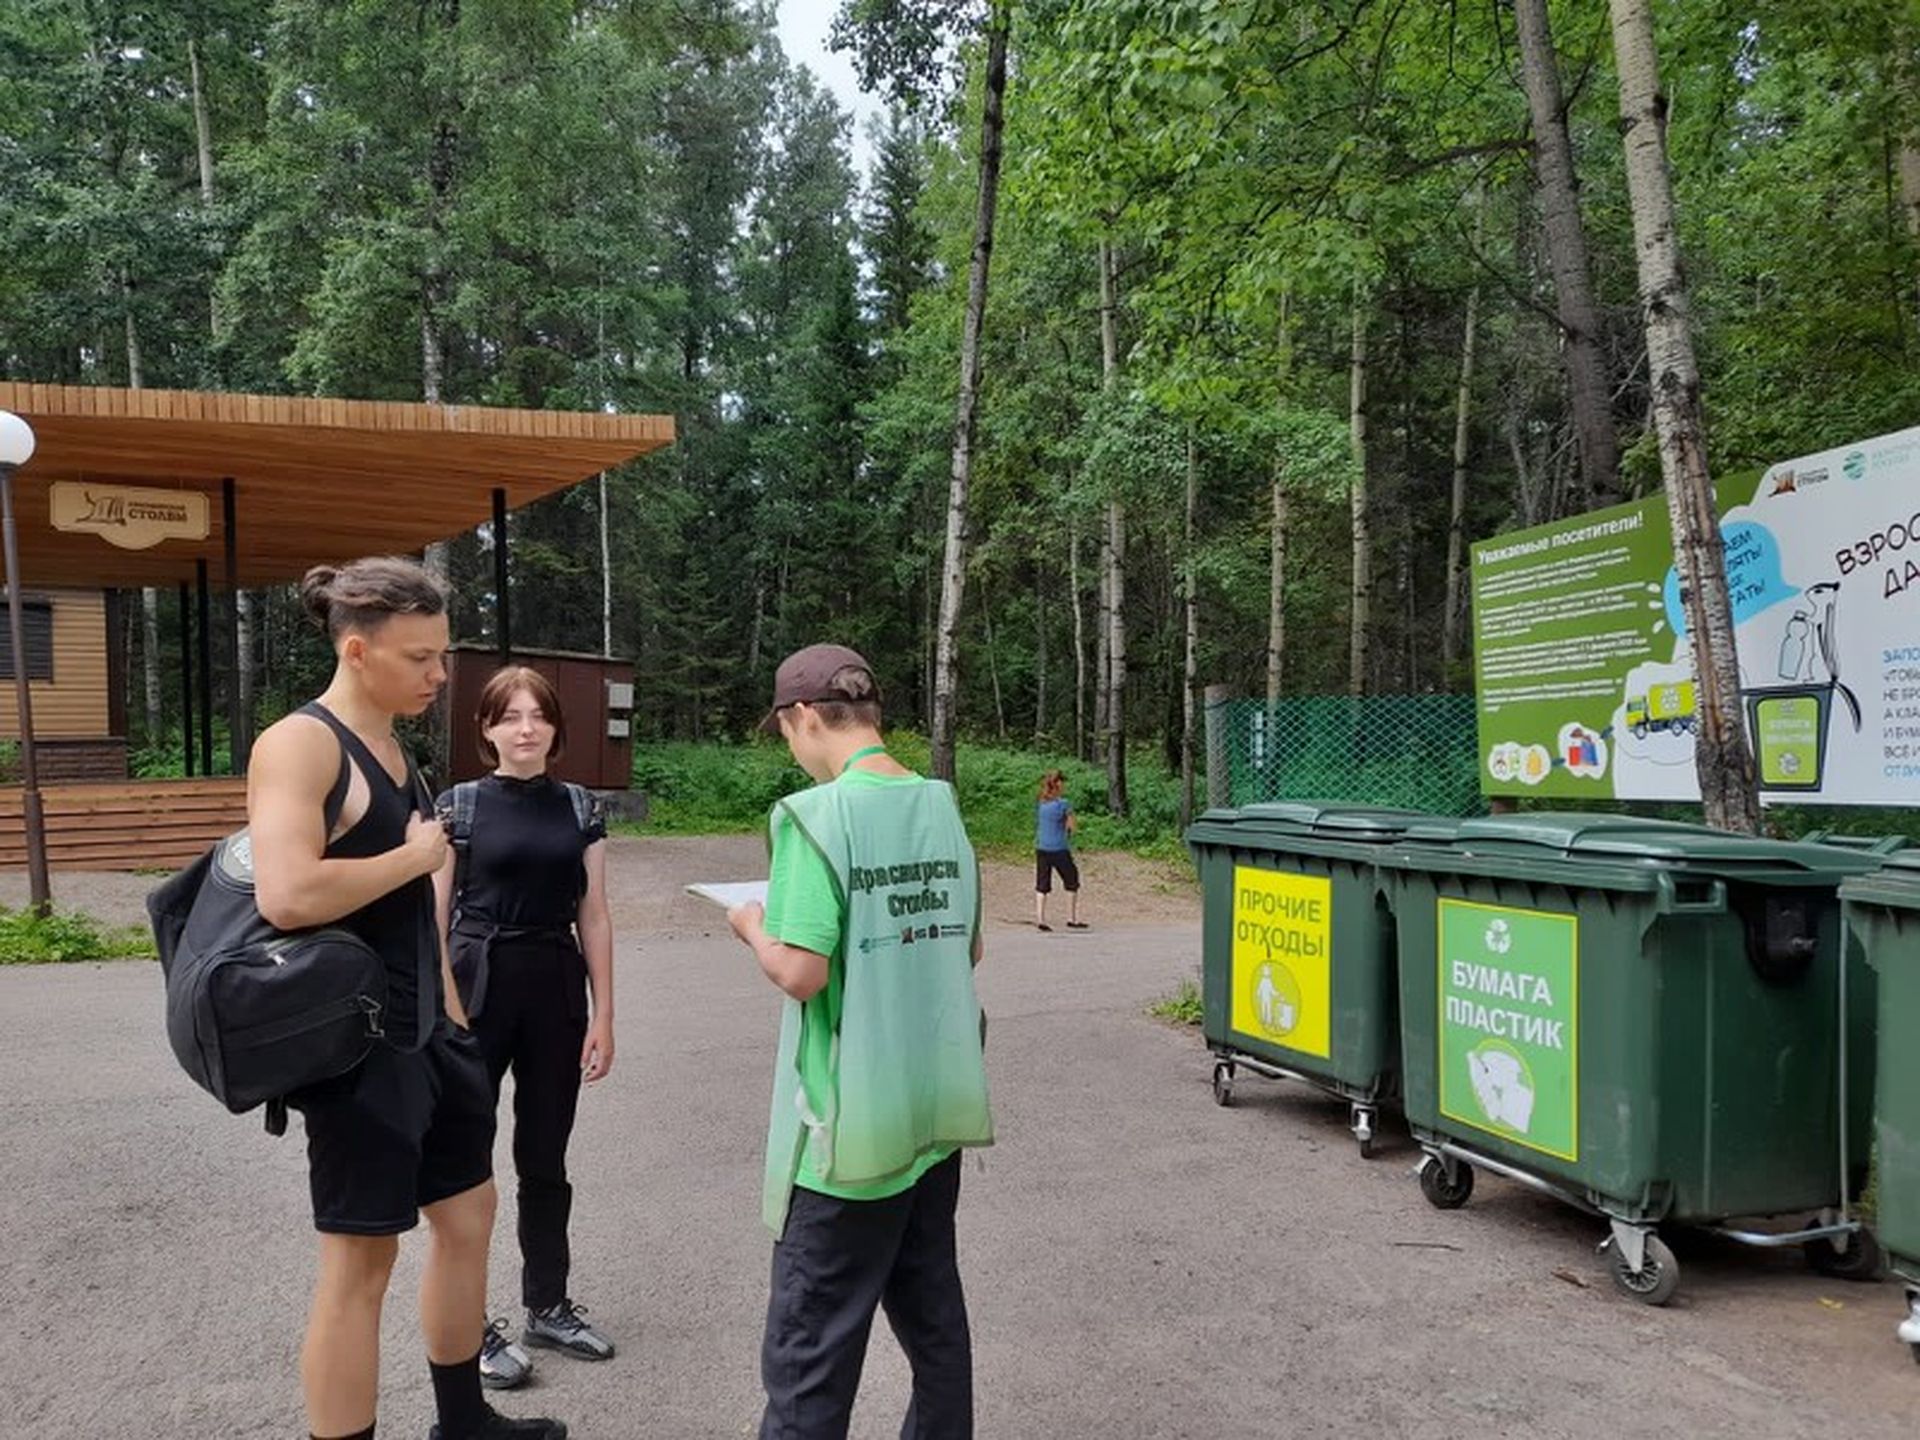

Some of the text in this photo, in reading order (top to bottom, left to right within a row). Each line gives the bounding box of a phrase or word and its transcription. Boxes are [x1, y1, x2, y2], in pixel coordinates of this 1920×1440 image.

[1478, 510, 1644, 564] Уважаемые посетители!
[1836, 513, 1920, 575] ВЗРОС
[1885, 560, 1920, 598] ДА
[1240, 888, 1321, 922] ПРОЧИЕ
[1237, 920, 1323, 957] ОТХОДЫ
[1452, 960, 1553, 1006] БУМАГА
[1446, 996, 1563, 1050] ПЛАСТИК
